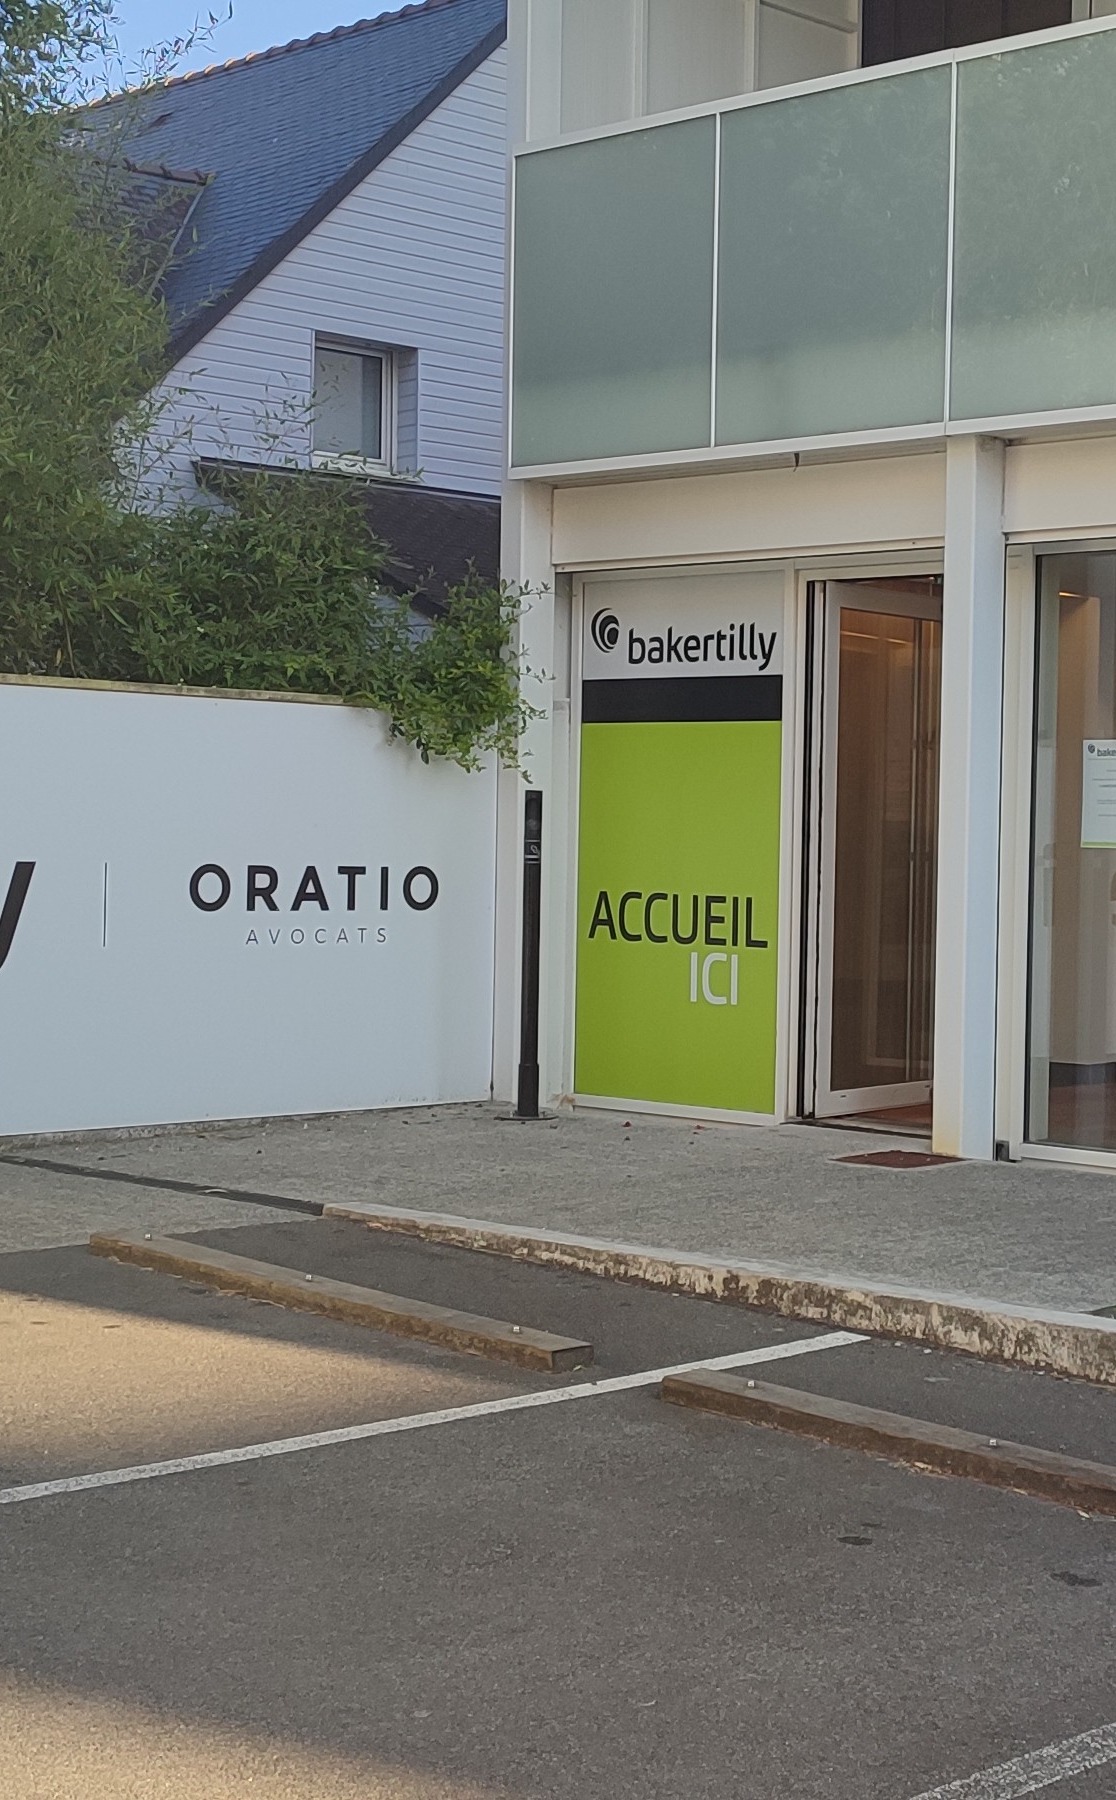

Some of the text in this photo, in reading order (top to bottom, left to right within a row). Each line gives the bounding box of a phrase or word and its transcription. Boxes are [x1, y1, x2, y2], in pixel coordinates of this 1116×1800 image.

[628, 622, 778, 671] bakertilly
[189, 863, 439, 912] ORATIO
[245, 927, 387, 946] AVOCATS
[588, 890, 769, 949] ACCUEIL
[689, 951, 739, 1006] ICI
